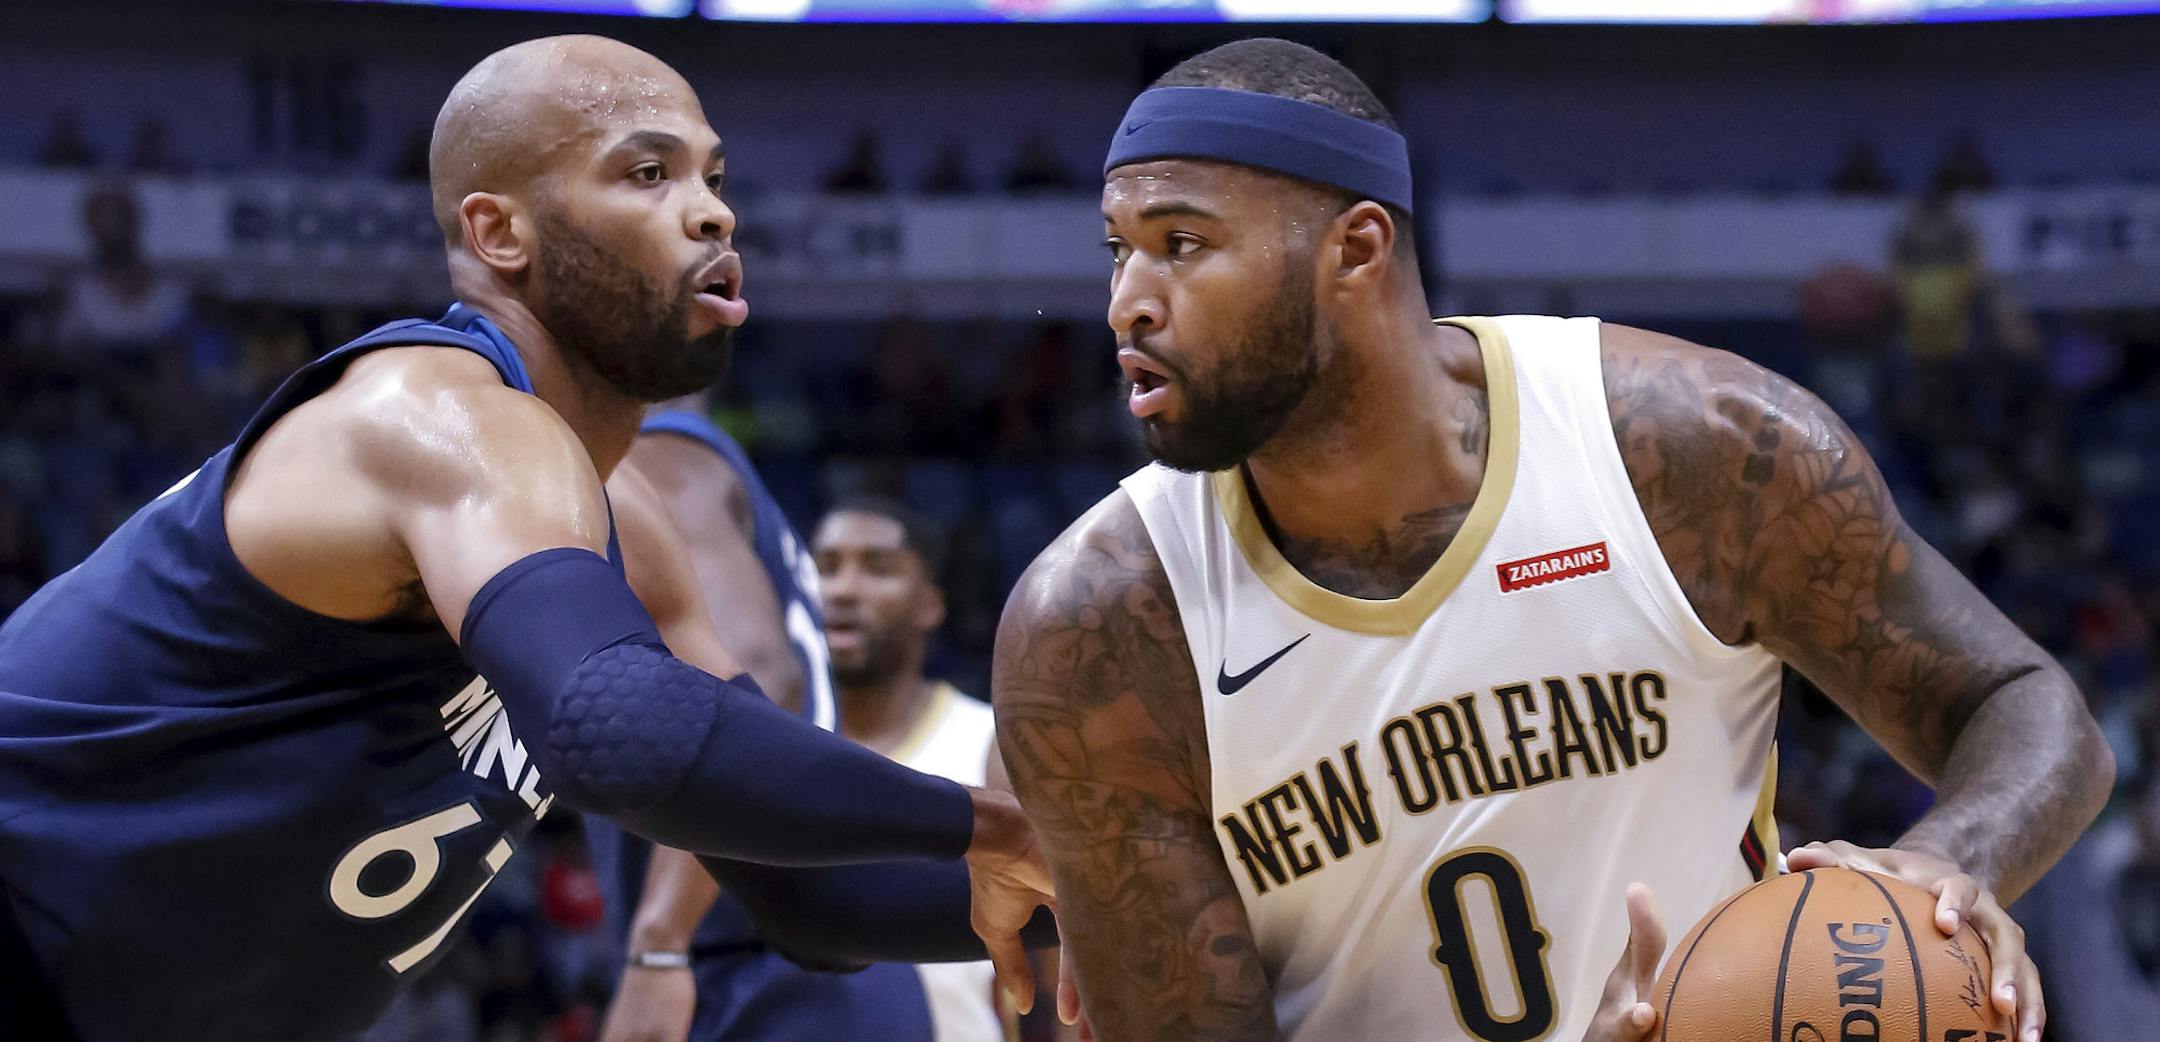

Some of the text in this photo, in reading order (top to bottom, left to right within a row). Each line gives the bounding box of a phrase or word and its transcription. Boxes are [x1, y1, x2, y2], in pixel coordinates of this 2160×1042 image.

[1509, 548, 1605, 582] ZATARAIN'S
[1219, 669, 1668, 897] NEW ORLEANS
[1421, 845, 1560, 1042] 0
